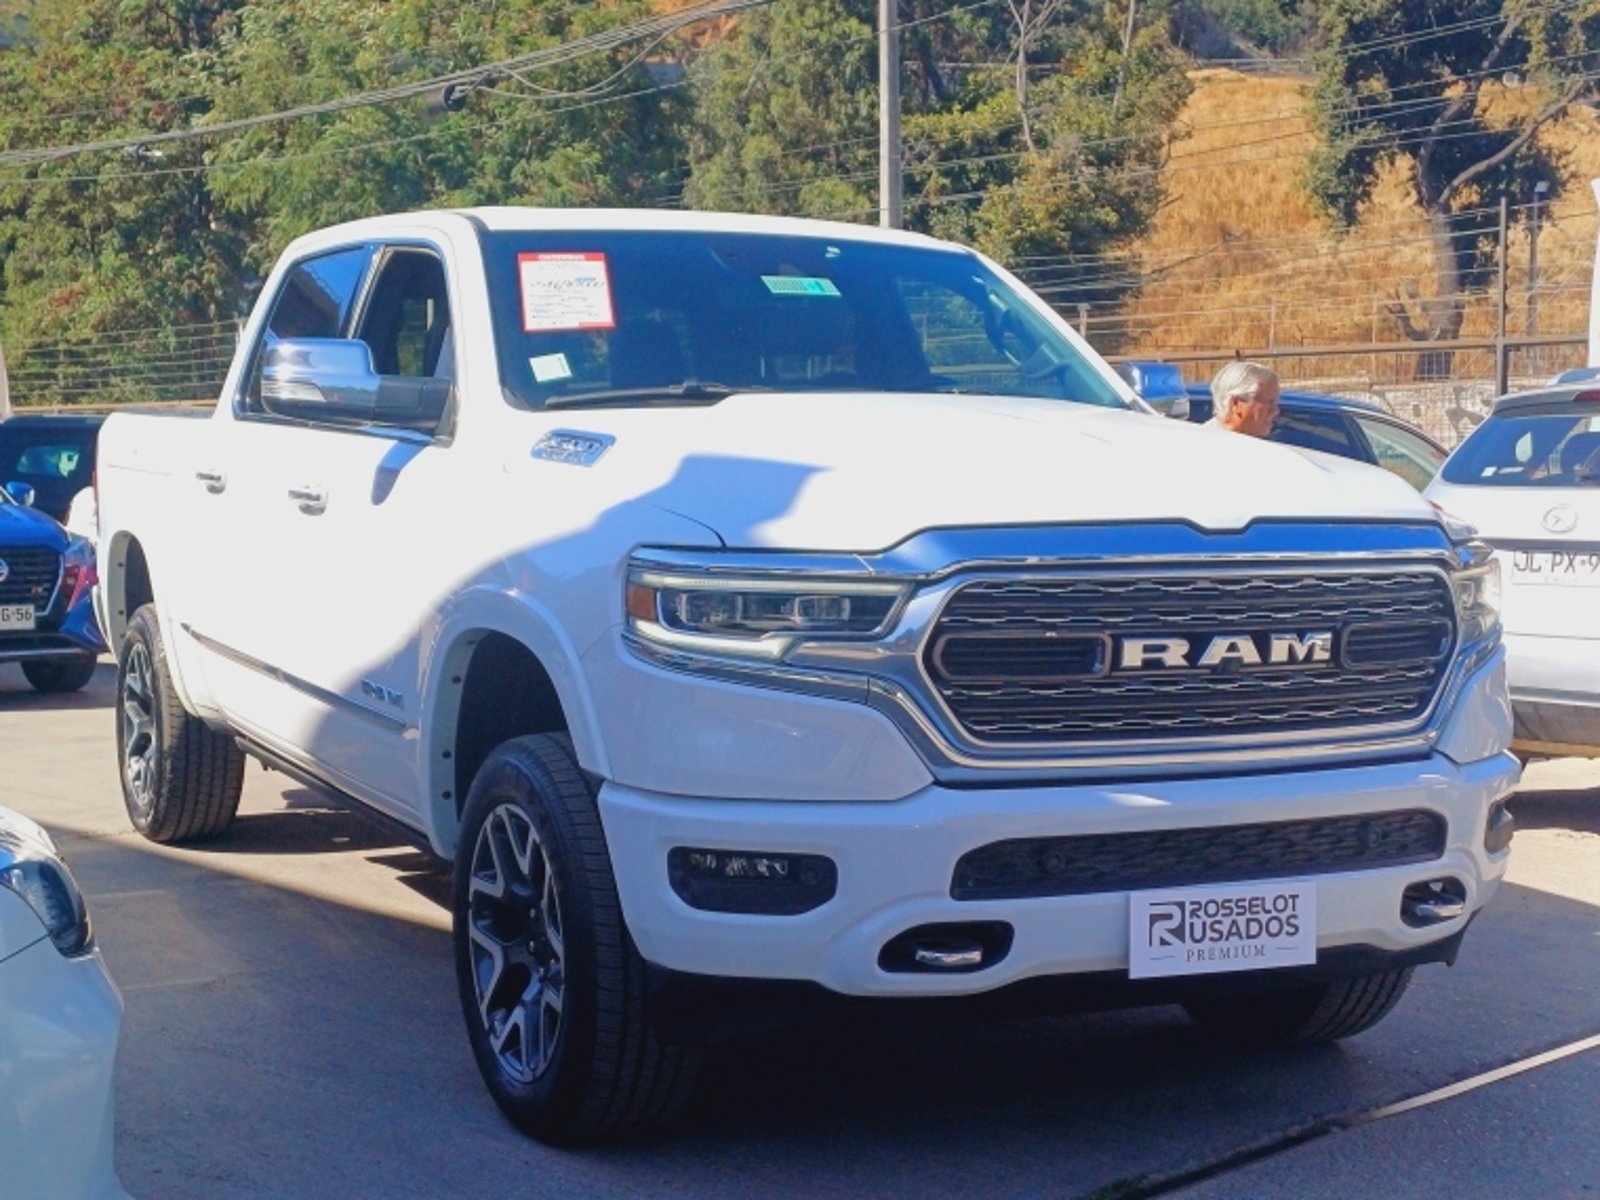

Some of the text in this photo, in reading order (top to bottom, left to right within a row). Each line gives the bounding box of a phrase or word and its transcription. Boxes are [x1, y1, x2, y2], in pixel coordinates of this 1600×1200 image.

[1121, 632, 1332, 668] RAM
[1188, 894, 1300, 920] ROSSELOT
[1188, 914, 1300, 944] USADOS
[1186, 945, 1266, 962] PREMIUM
